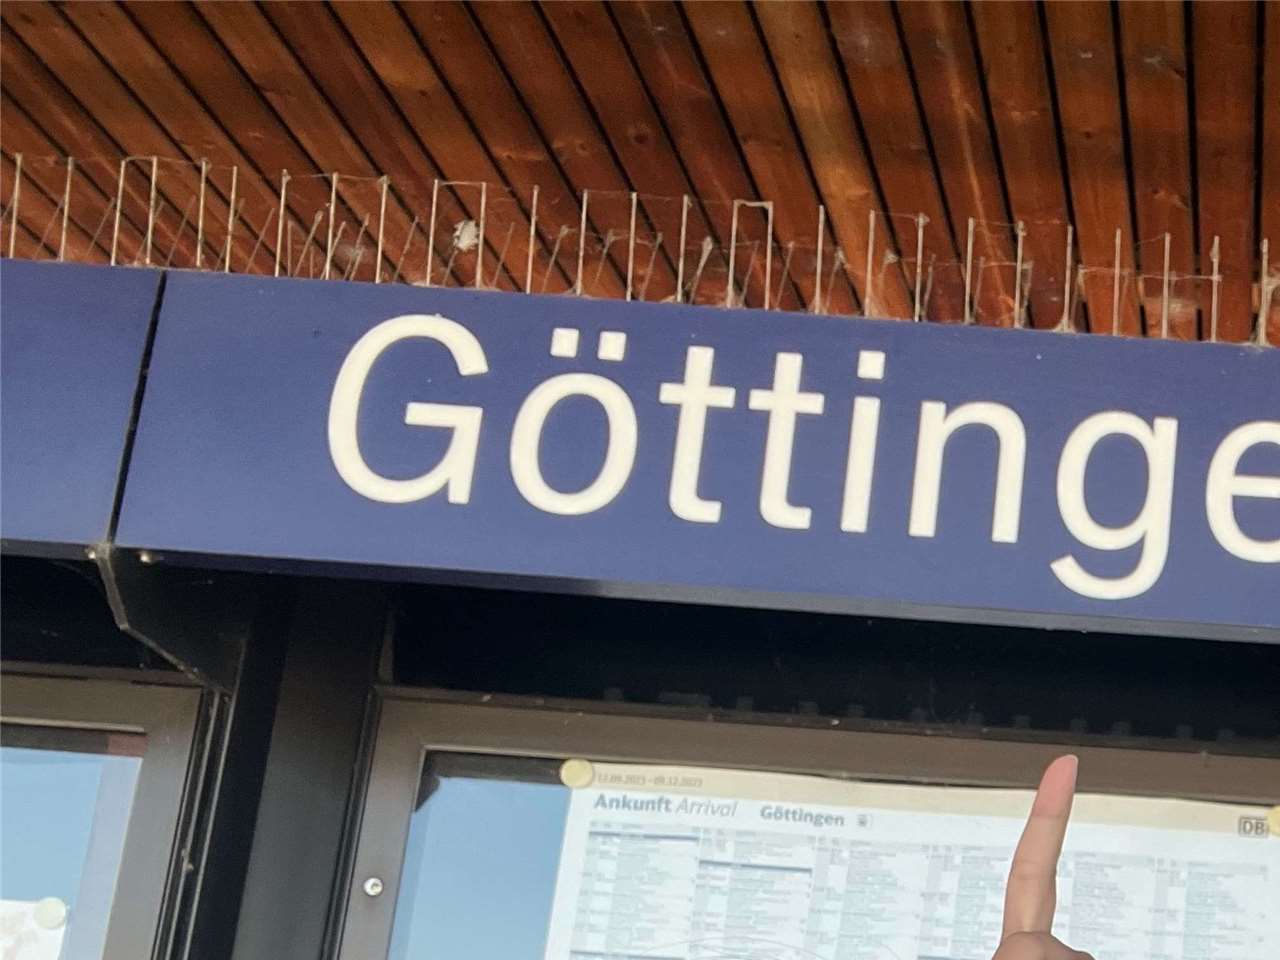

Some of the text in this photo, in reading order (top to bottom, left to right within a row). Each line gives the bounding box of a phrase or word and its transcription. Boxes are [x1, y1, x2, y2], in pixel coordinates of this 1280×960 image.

[594, 793, 738, 817] Ankunft Arrival
[760, 804, 845, 828] Göttingen
[1242, 819, 1266, 836] DB
